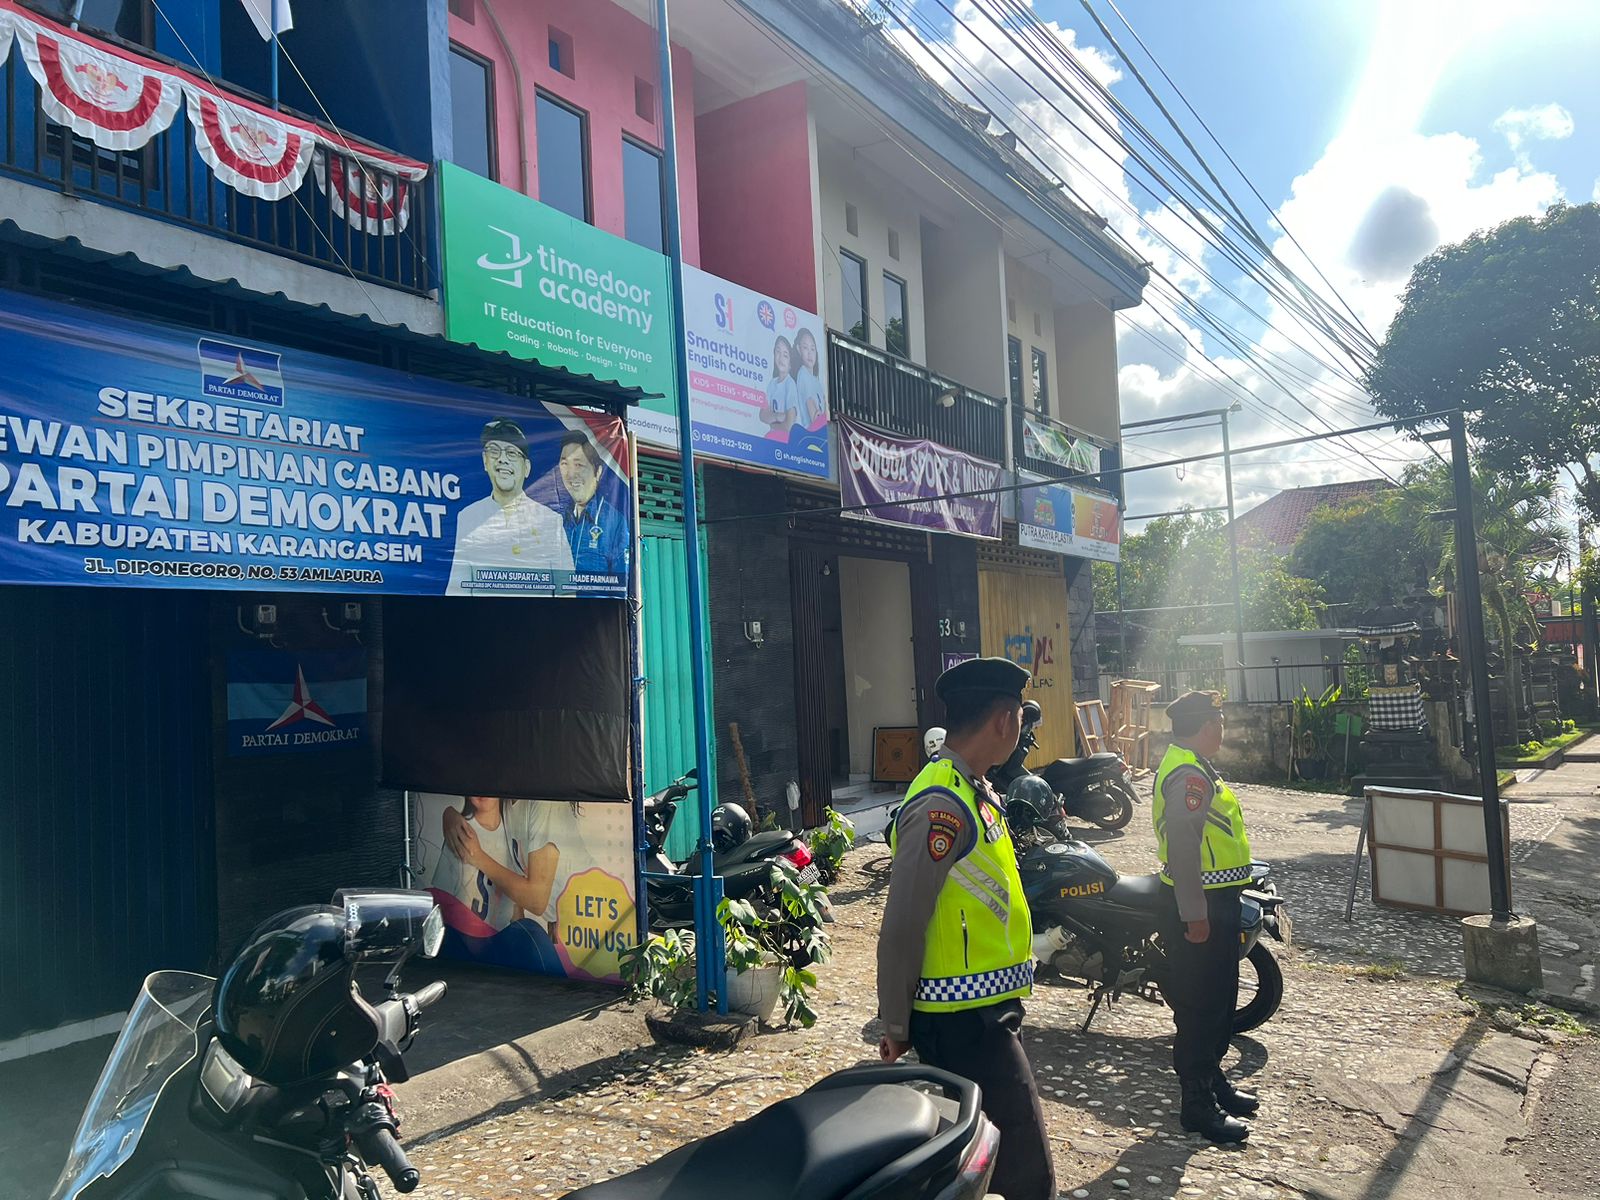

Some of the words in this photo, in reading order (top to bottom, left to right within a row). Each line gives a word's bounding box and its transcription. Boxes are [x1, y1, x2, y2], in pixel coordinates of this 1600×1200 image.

[537, 245, 652, 306] timedoor
[538, 276, 653, 334] academy
[484, 302, 497, 317] IT
[500, 307, 574, 340] Education
[575, 330, 594, 346] for
[597, 336, 653, 363] Everyone
[507, 330, 540, 349] Coding
[547, 342, 579, 358] Robotic
[586, 352, 613, 368] Design
[619, 362, 638, 374] STEM
[687, 330, 769, 369] SmartHouse
[688, 350, 727, 371] English
[728, 363, 765, 383] Course
[208, 384, 236, 395] PARTAI
[237, 389, 280, 403] DEMOKRAT
[693, 377, 710, 389] KIDS
[716, 384, 736, 397] TEENS
[742, 390, 765, 405] PUBLIC
[97, 387, 365, 451] SEKRETARIAT
[702, 433, 752, 452] 0878-6122-5292
[137, 434, 328, 486] PIMPINAN
[333, 460, 462, 500] CABANG
[783, 452, 826, 469] sh.englishcourse
[911, 450, 950, 492] SPORT
[962, 463, 997, 504] MUSIC
[202, 481, 447, 538] DEMOKRAT
[18, 518, 232, 553] KABUPATEN
[237, 533, 422, 563] KARANGASEM
[1020, 524, 1038, 540] PUTRA
[1038, 529, 1055, 542] KARYA
[1055, 532, 1074, 545] PLASTIK
[84, 558, 113, 573] JL.
[116, 560, 244, 579] DIPONEGORO,
[247, 565, 276, 579] NO.
[279, 567, 298, 579] 53
[300, 568, 383, 584] AMLAPURA
[481, 570, 508, 581] WAYAN
[508, 571, 541, 583] SUPARTA,
[542, 573, 550, 582] SE
[939, 618, 951, 637] 53
[242, 733, 289, 747] PARTAI
[294, 728, 360, 745] DEMOKRAT
[1060, 881, 1104, 898] POLISI
[576, 895, 618, 920] LET'S
[565, 925, 600, 950] JOIN
[604, 931, 632, 952] US!
